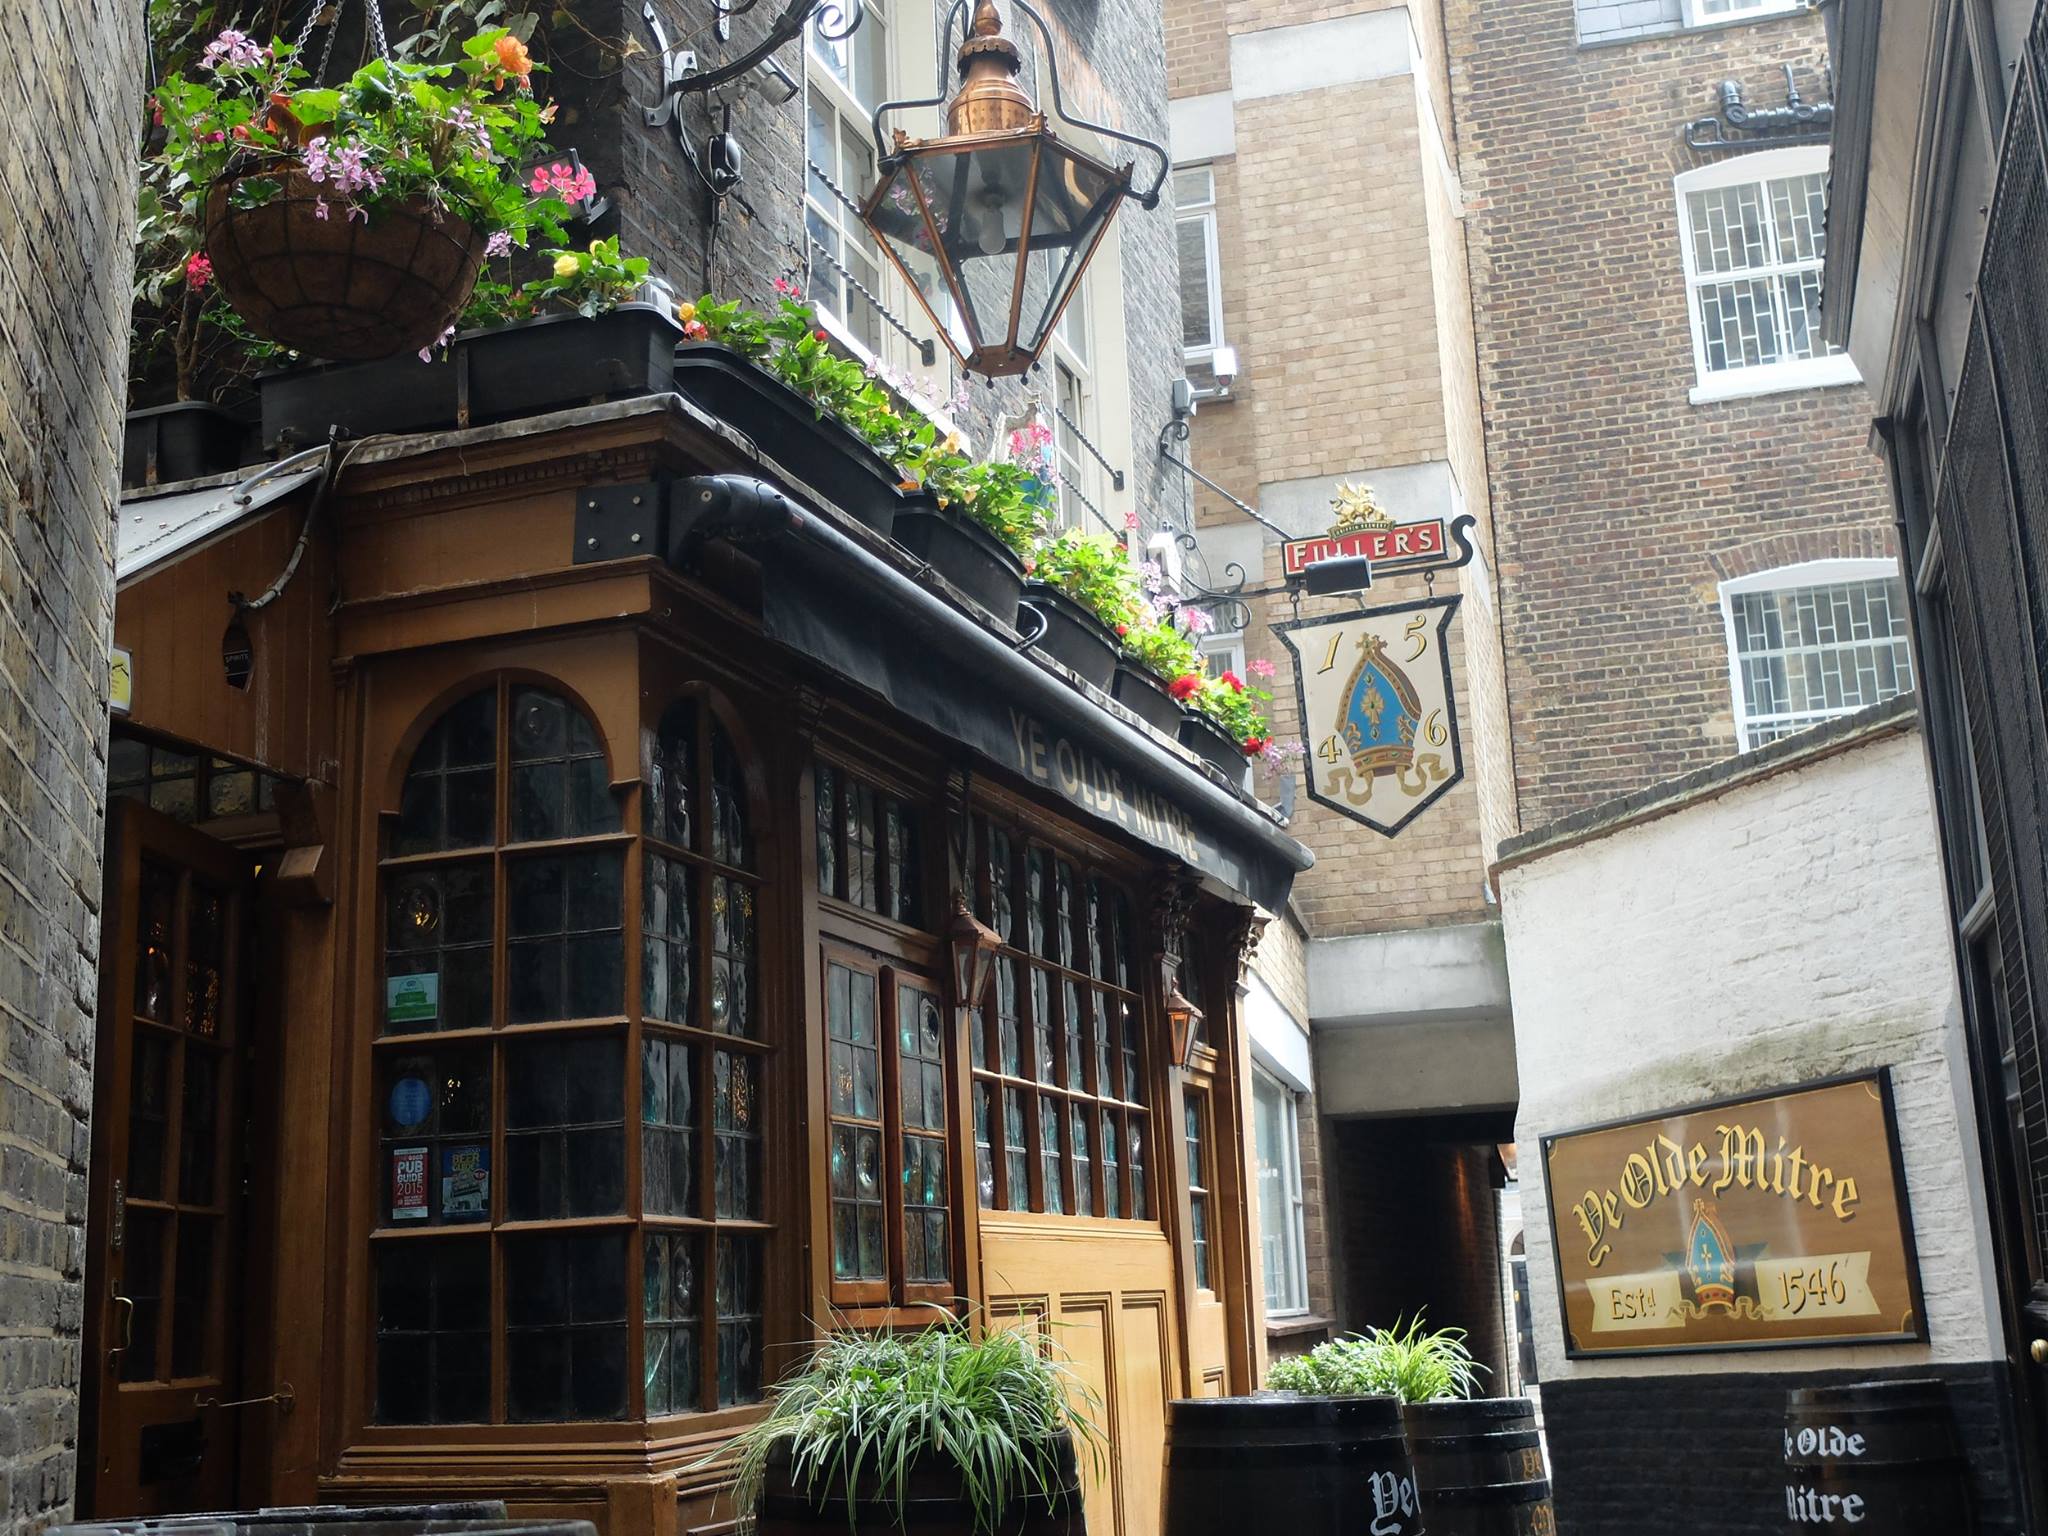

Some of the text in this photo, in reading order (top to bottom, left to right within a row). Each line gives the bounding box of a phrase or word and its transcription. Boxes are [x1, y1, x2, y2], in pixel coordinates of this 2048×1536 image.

[1317, 613, 1427, 674] 1 5
[1317, 708, 1447, 764] 4 6
[1009, 706, 1200, 862] YE OLDE MITRE
[397, 1160, 424, 1174] PUB
[397, 1172, 424, 1184] GUIDE
[397, 1182, 424, 1196] 2015
[1572, 1123, 1860, 1268] Ye Olde Mitre
[1777, 1260, 1847, 1315] 1546
[1797, 1425, 1867, 1456] Olde
